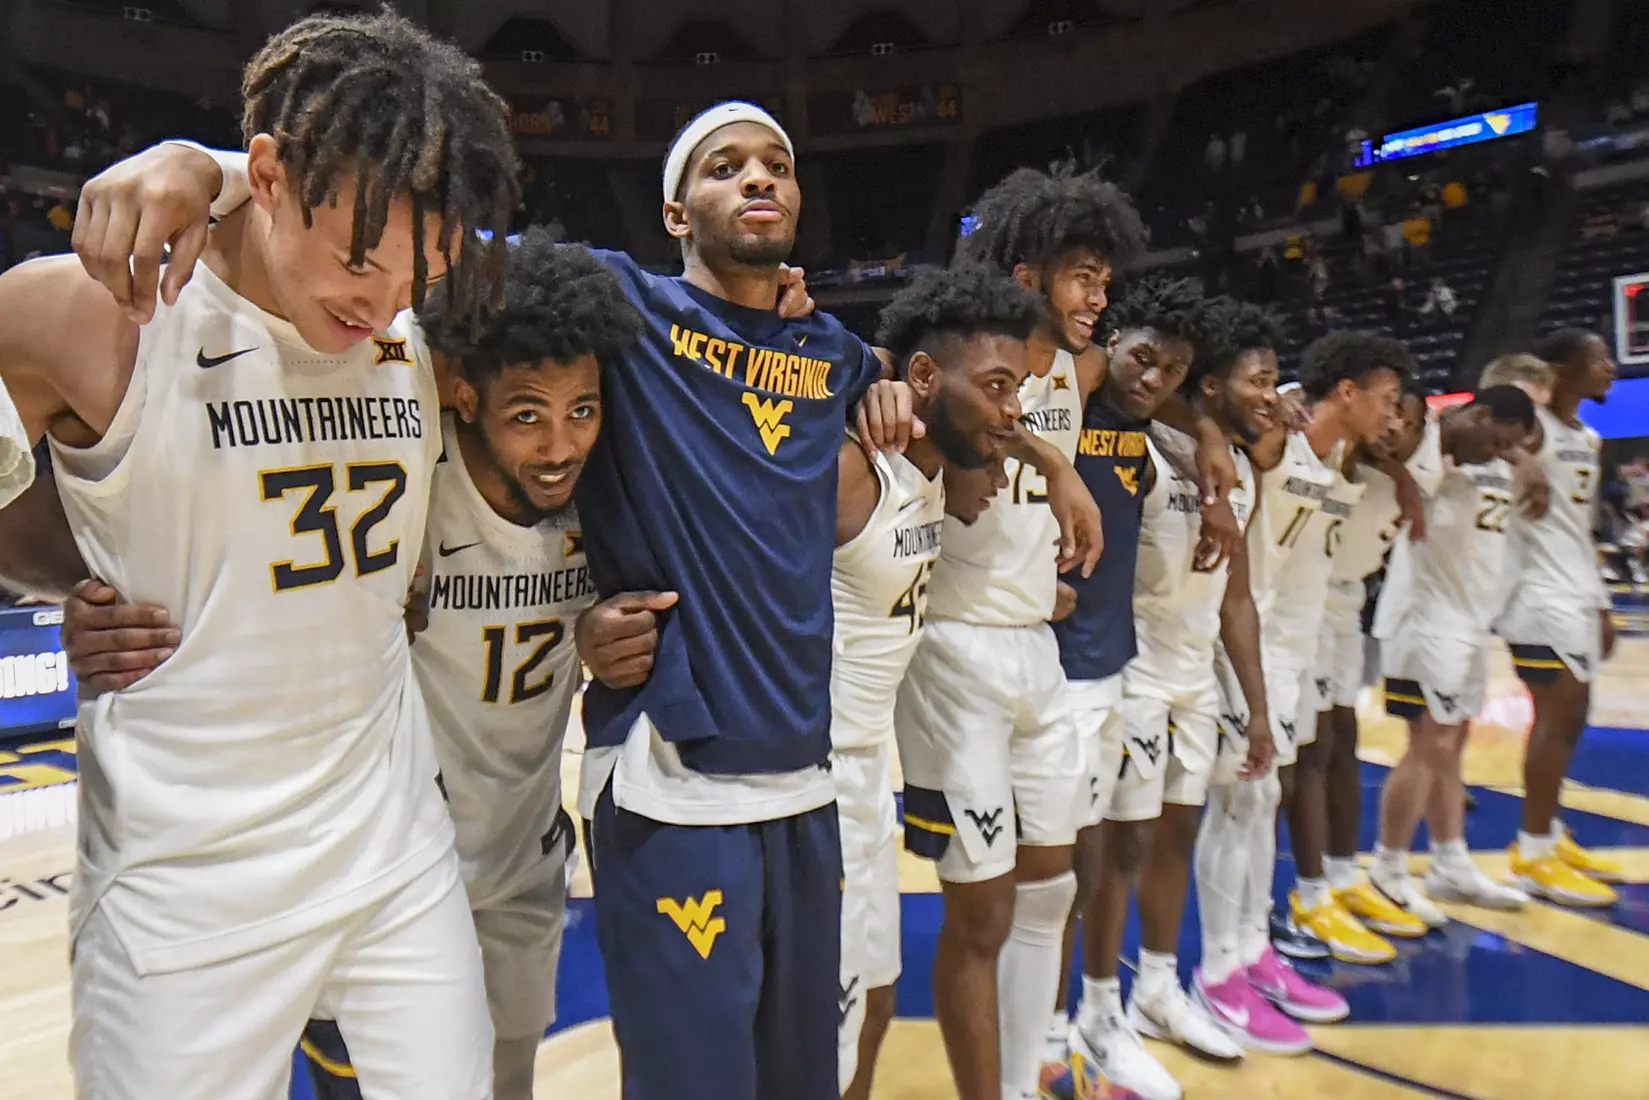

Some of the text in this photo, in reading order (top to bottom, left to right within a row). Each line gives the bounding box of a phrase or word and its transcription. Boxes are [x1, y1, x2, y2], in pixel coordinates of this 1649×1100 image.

[669, 323, 834, 399] WEST VIRGINIA
[206, 397, 422, 449] MOUNTAINEERS
[1079, 429, 1118, 457] WEST
[258, 460, 408, 592] 32
[481, 618, 564, 705] 12
